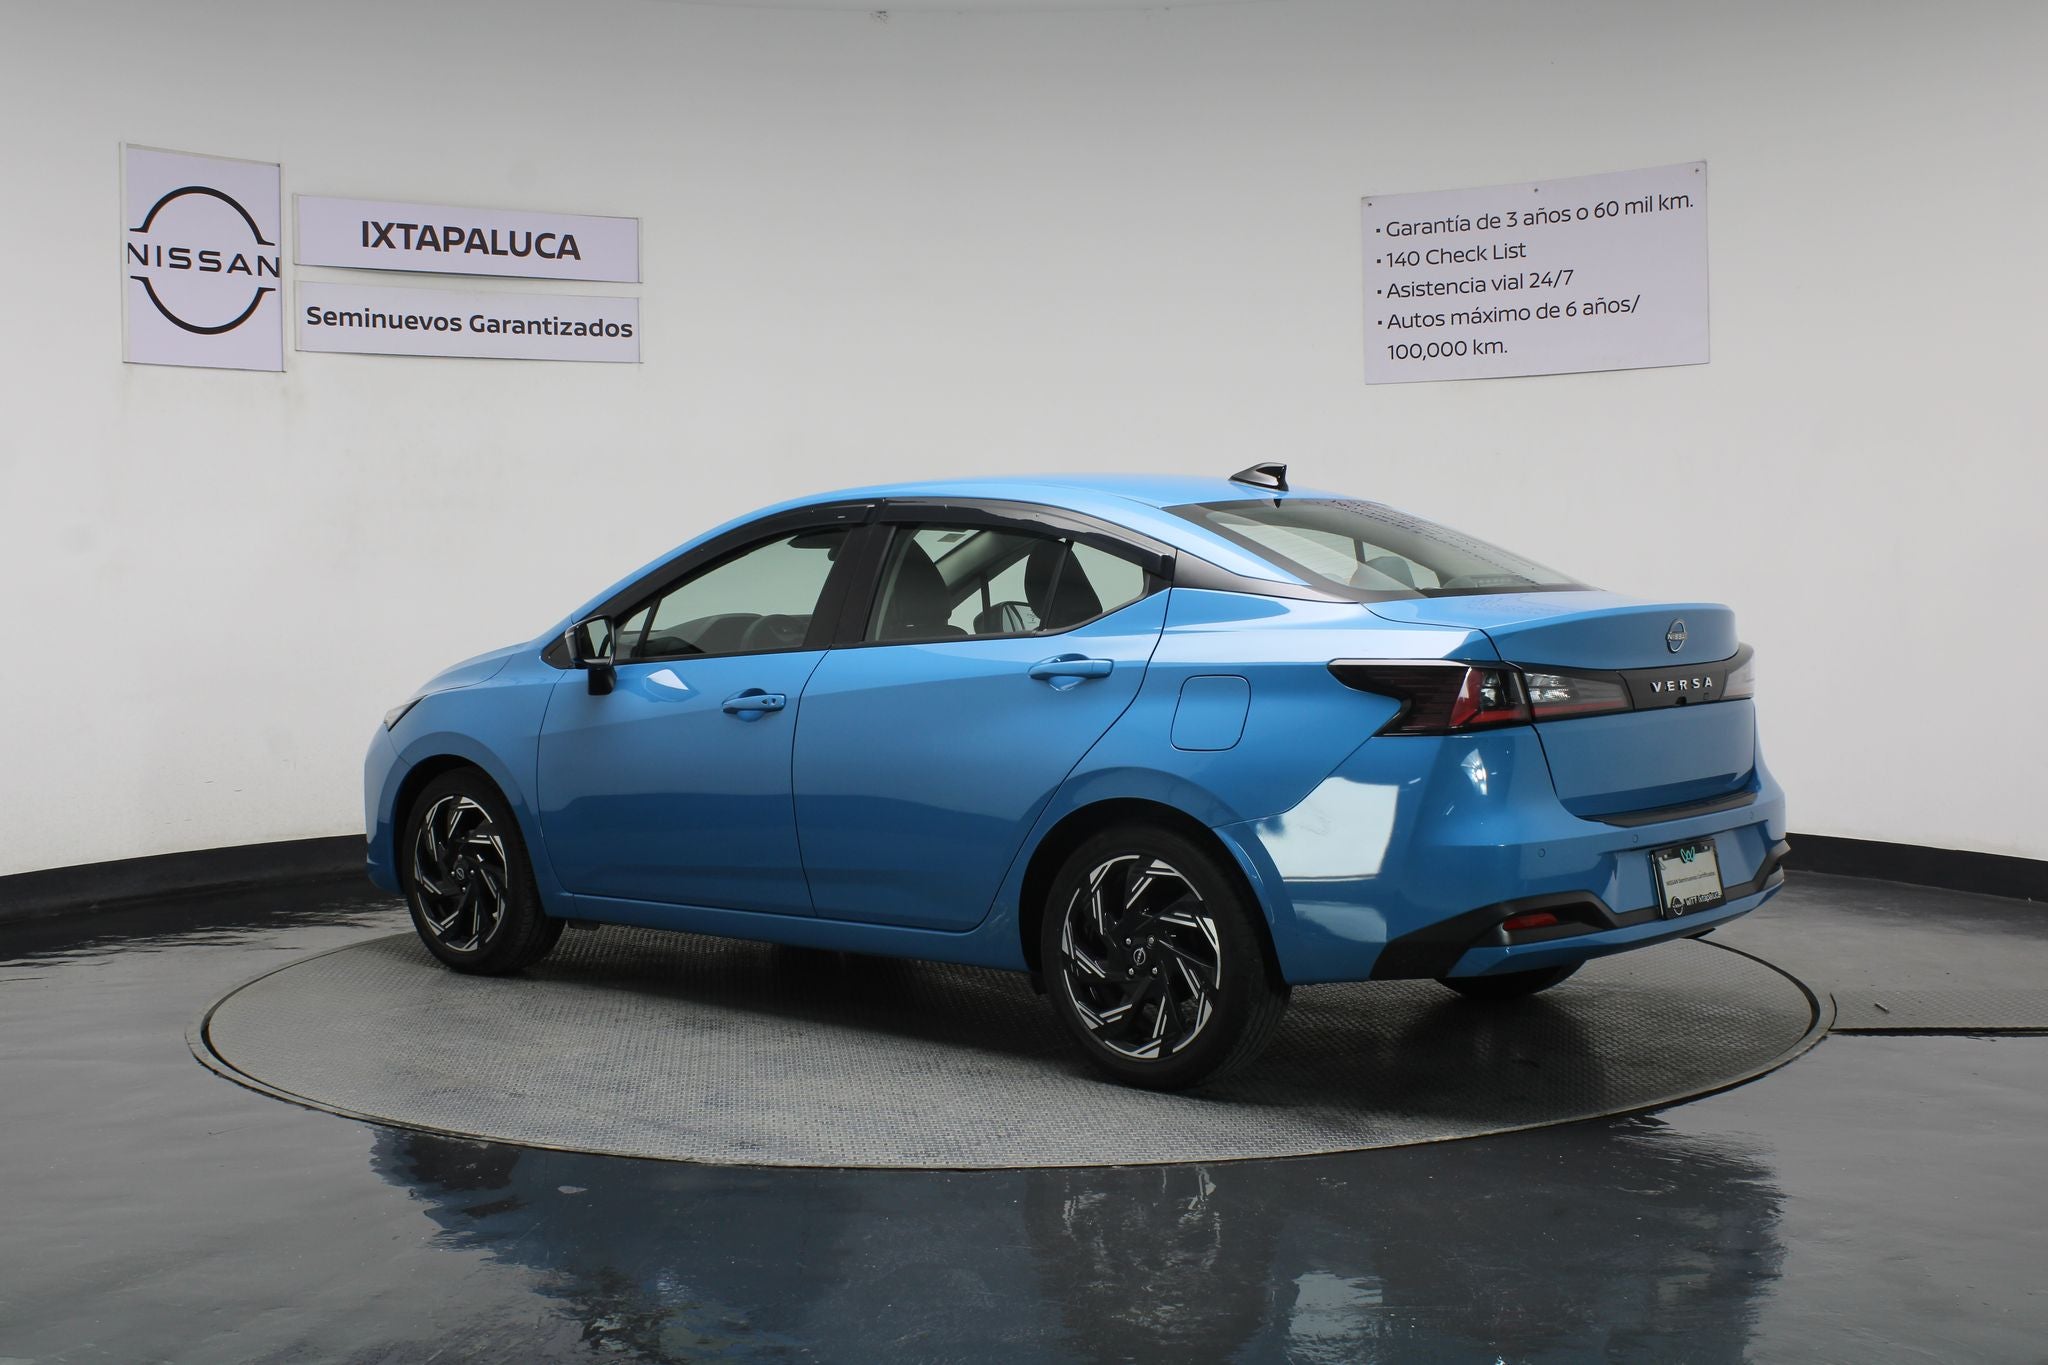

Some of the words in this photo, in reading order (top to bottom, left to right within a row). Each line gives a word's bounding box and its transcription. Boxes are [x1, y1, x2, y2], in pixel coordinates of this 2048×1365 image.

[1386, 214, 1471, 238] Garantía
[1476, 213, 1501, 230] de
[1506, 211, 1518, 228] 3
[1523, 207, 1572, 226] años
[1576, 207, 1589, 221] o
[1594, 200, 1620, 219] 60
[1624, 196, 1653, 216] mil
[1658, 193, 1694, 212] km.
[362, 220, 582, 262] IXTAPALUCA
[1386, 250, 1421, 268] 140
[1425, 245, 1488, 265] Check
[1493, 242, 1527, 260] List
[127, 242, 281, 279] NISSAN
[1386, 277, 1487, 299] Asistencia
[1491, 272, 1524, 291] vial
[1529, 269, 1574, 289] 24/7
[306, 305, 463, 332] Seminuevos
[469, 314, 633, 339] Garantizados
[1387, 312, 1446, 330] Autos
[1450, 306, 1531, 327] máximo
[1535, 302, 1561, 320] de
[1565, 301, 1577, 318] 6
[1582, 294, 1641, 316] años/
[1387, 340, 1468, 361] 100,000
[1472, 338, 1509, 356] km.
[1651, 677, 1713, 693] VERSA
